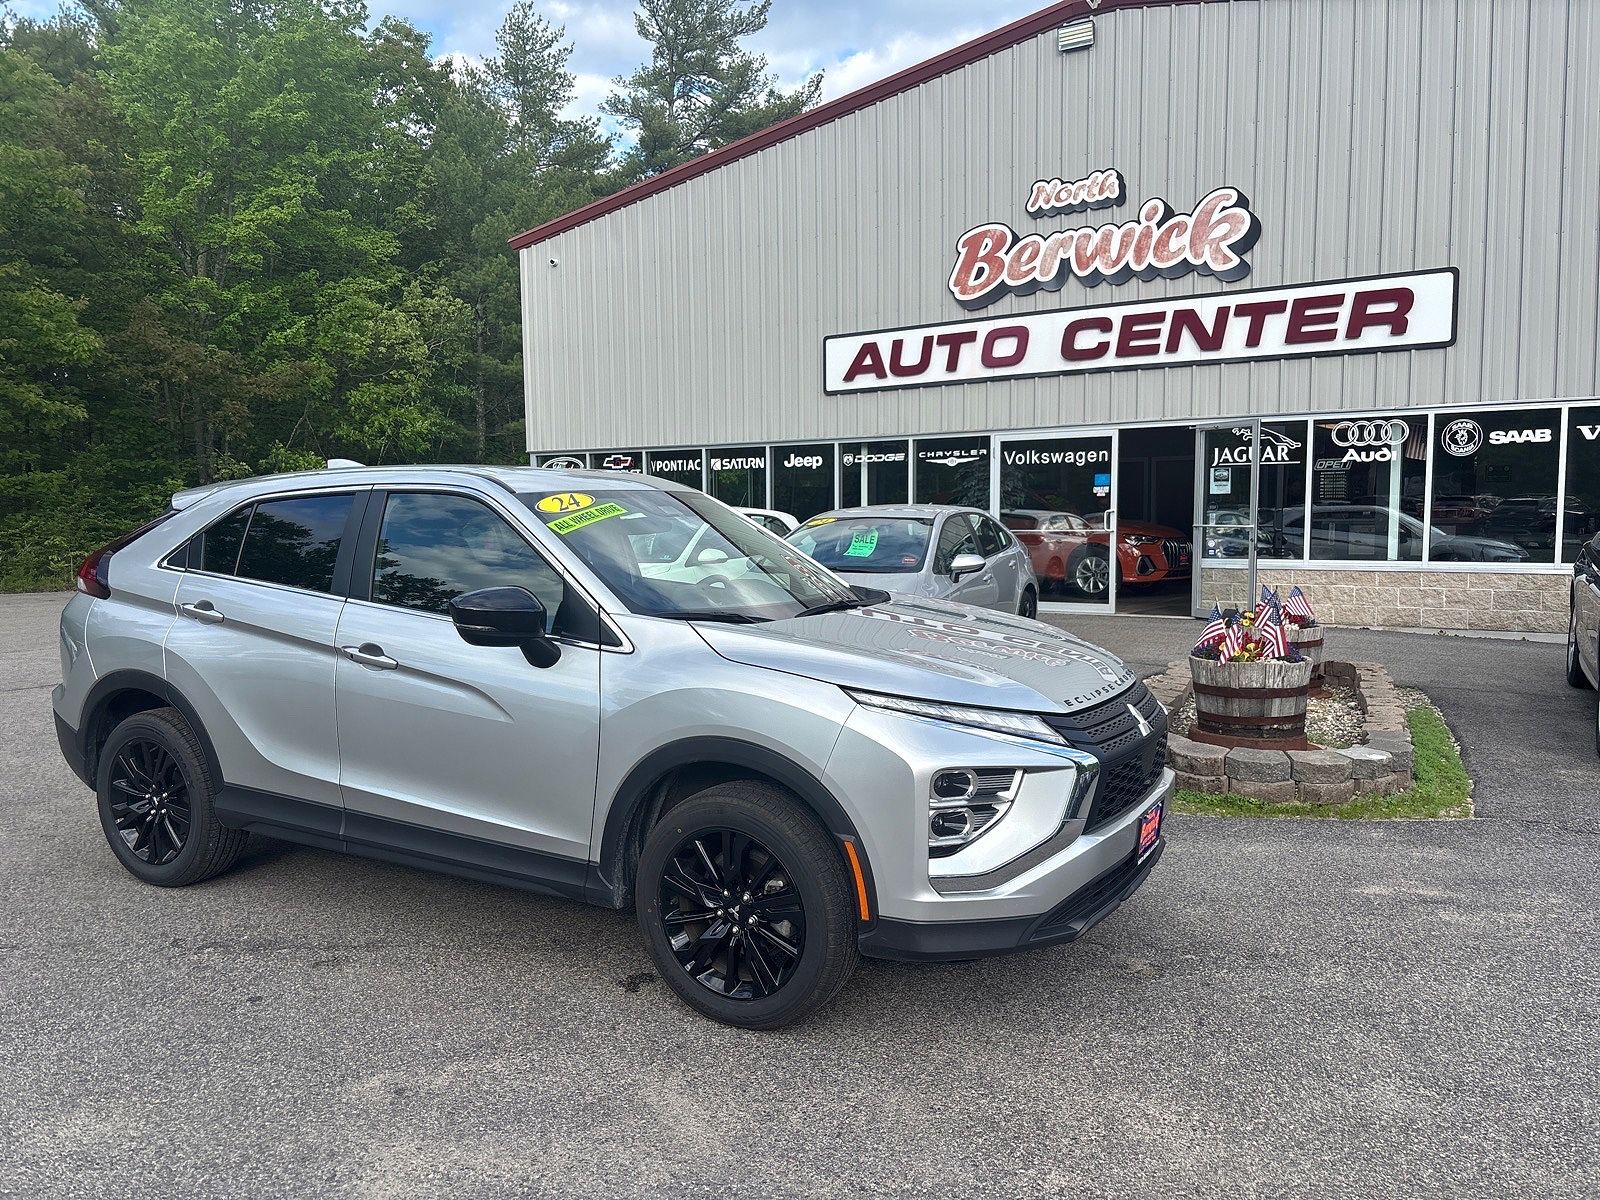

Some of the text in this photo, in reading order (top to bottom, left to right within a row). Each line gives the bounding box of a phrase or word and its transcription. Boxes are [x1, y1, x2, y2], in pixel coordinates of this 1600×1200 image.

[1029, 171, 1118, 209] North
[952, 192, 1247, 297] Berwick
[842, 286, 1417, 383] AUTO CENTER
[1488, 429, 1552, 445] SAAB
[784, 453, 823, 469] Jeep
[855, 453, 905, 463] DODGE
[919, 449, 987, 458] CHRYSLER
[1004, 450, 1109, 466] Volkswagen
[1341, 447, 1397, 462] Audi
[656, 459, 701, 471] PONTIAC
[722, 457, 765, 469] SATURN
[551, 493, 581, 511] 24
[554, 504, 620, 531] ALL WHEEL DRIVE
[854, 534, 875, 544] SALE
[1063, 683, 1116, 707] ECLIPSE
